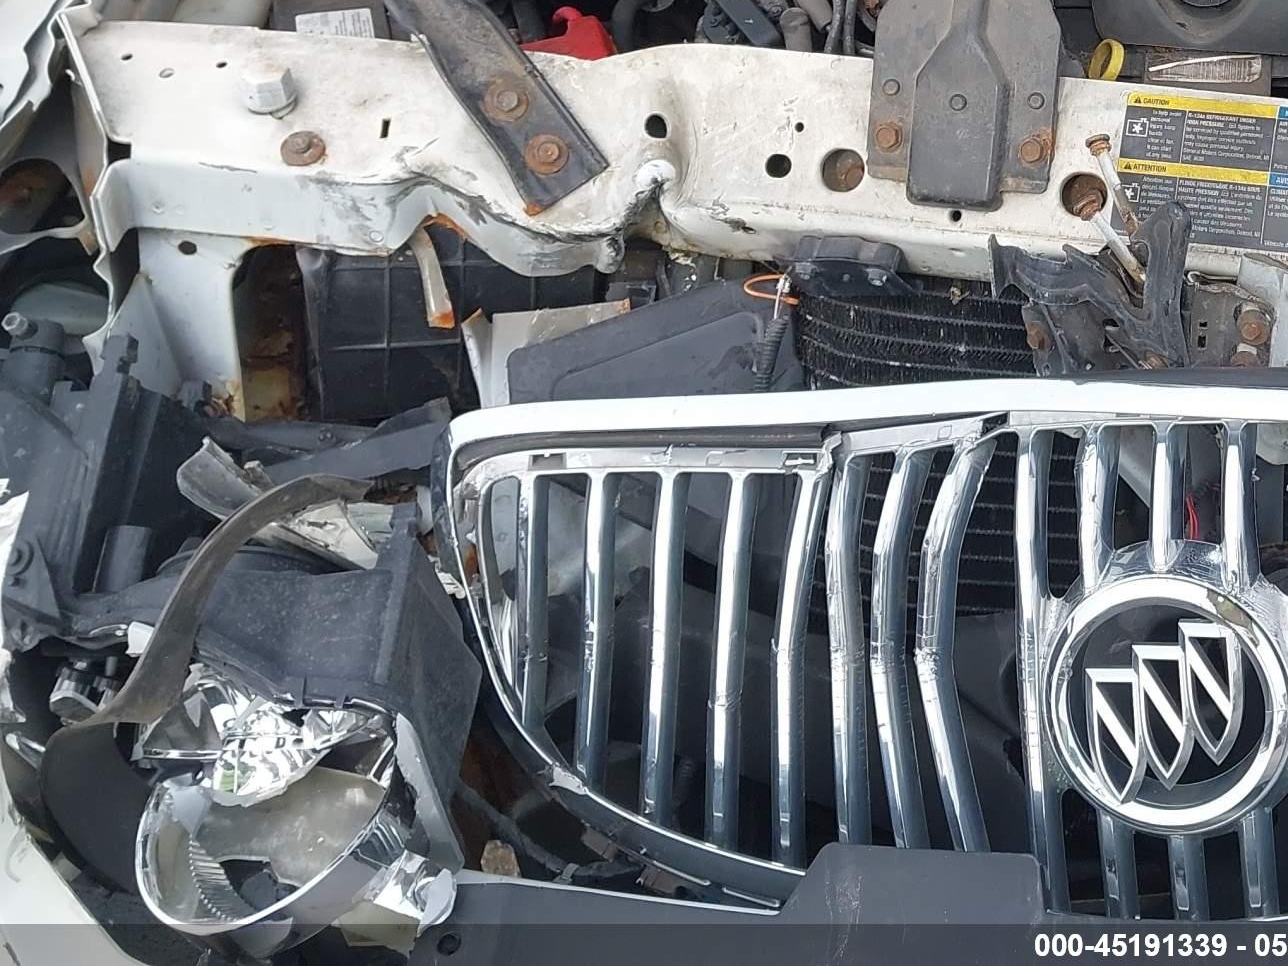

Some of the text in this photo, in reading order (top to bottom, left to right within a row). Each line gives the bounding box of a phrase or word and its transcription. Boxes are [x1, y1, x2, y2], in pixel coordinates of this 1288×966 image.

[1142, 97, 1169, 106] CAUTION
[1132, 162, 1167, 172] ATTENTION
[1194, 188, 1219, 196] PRESSION
